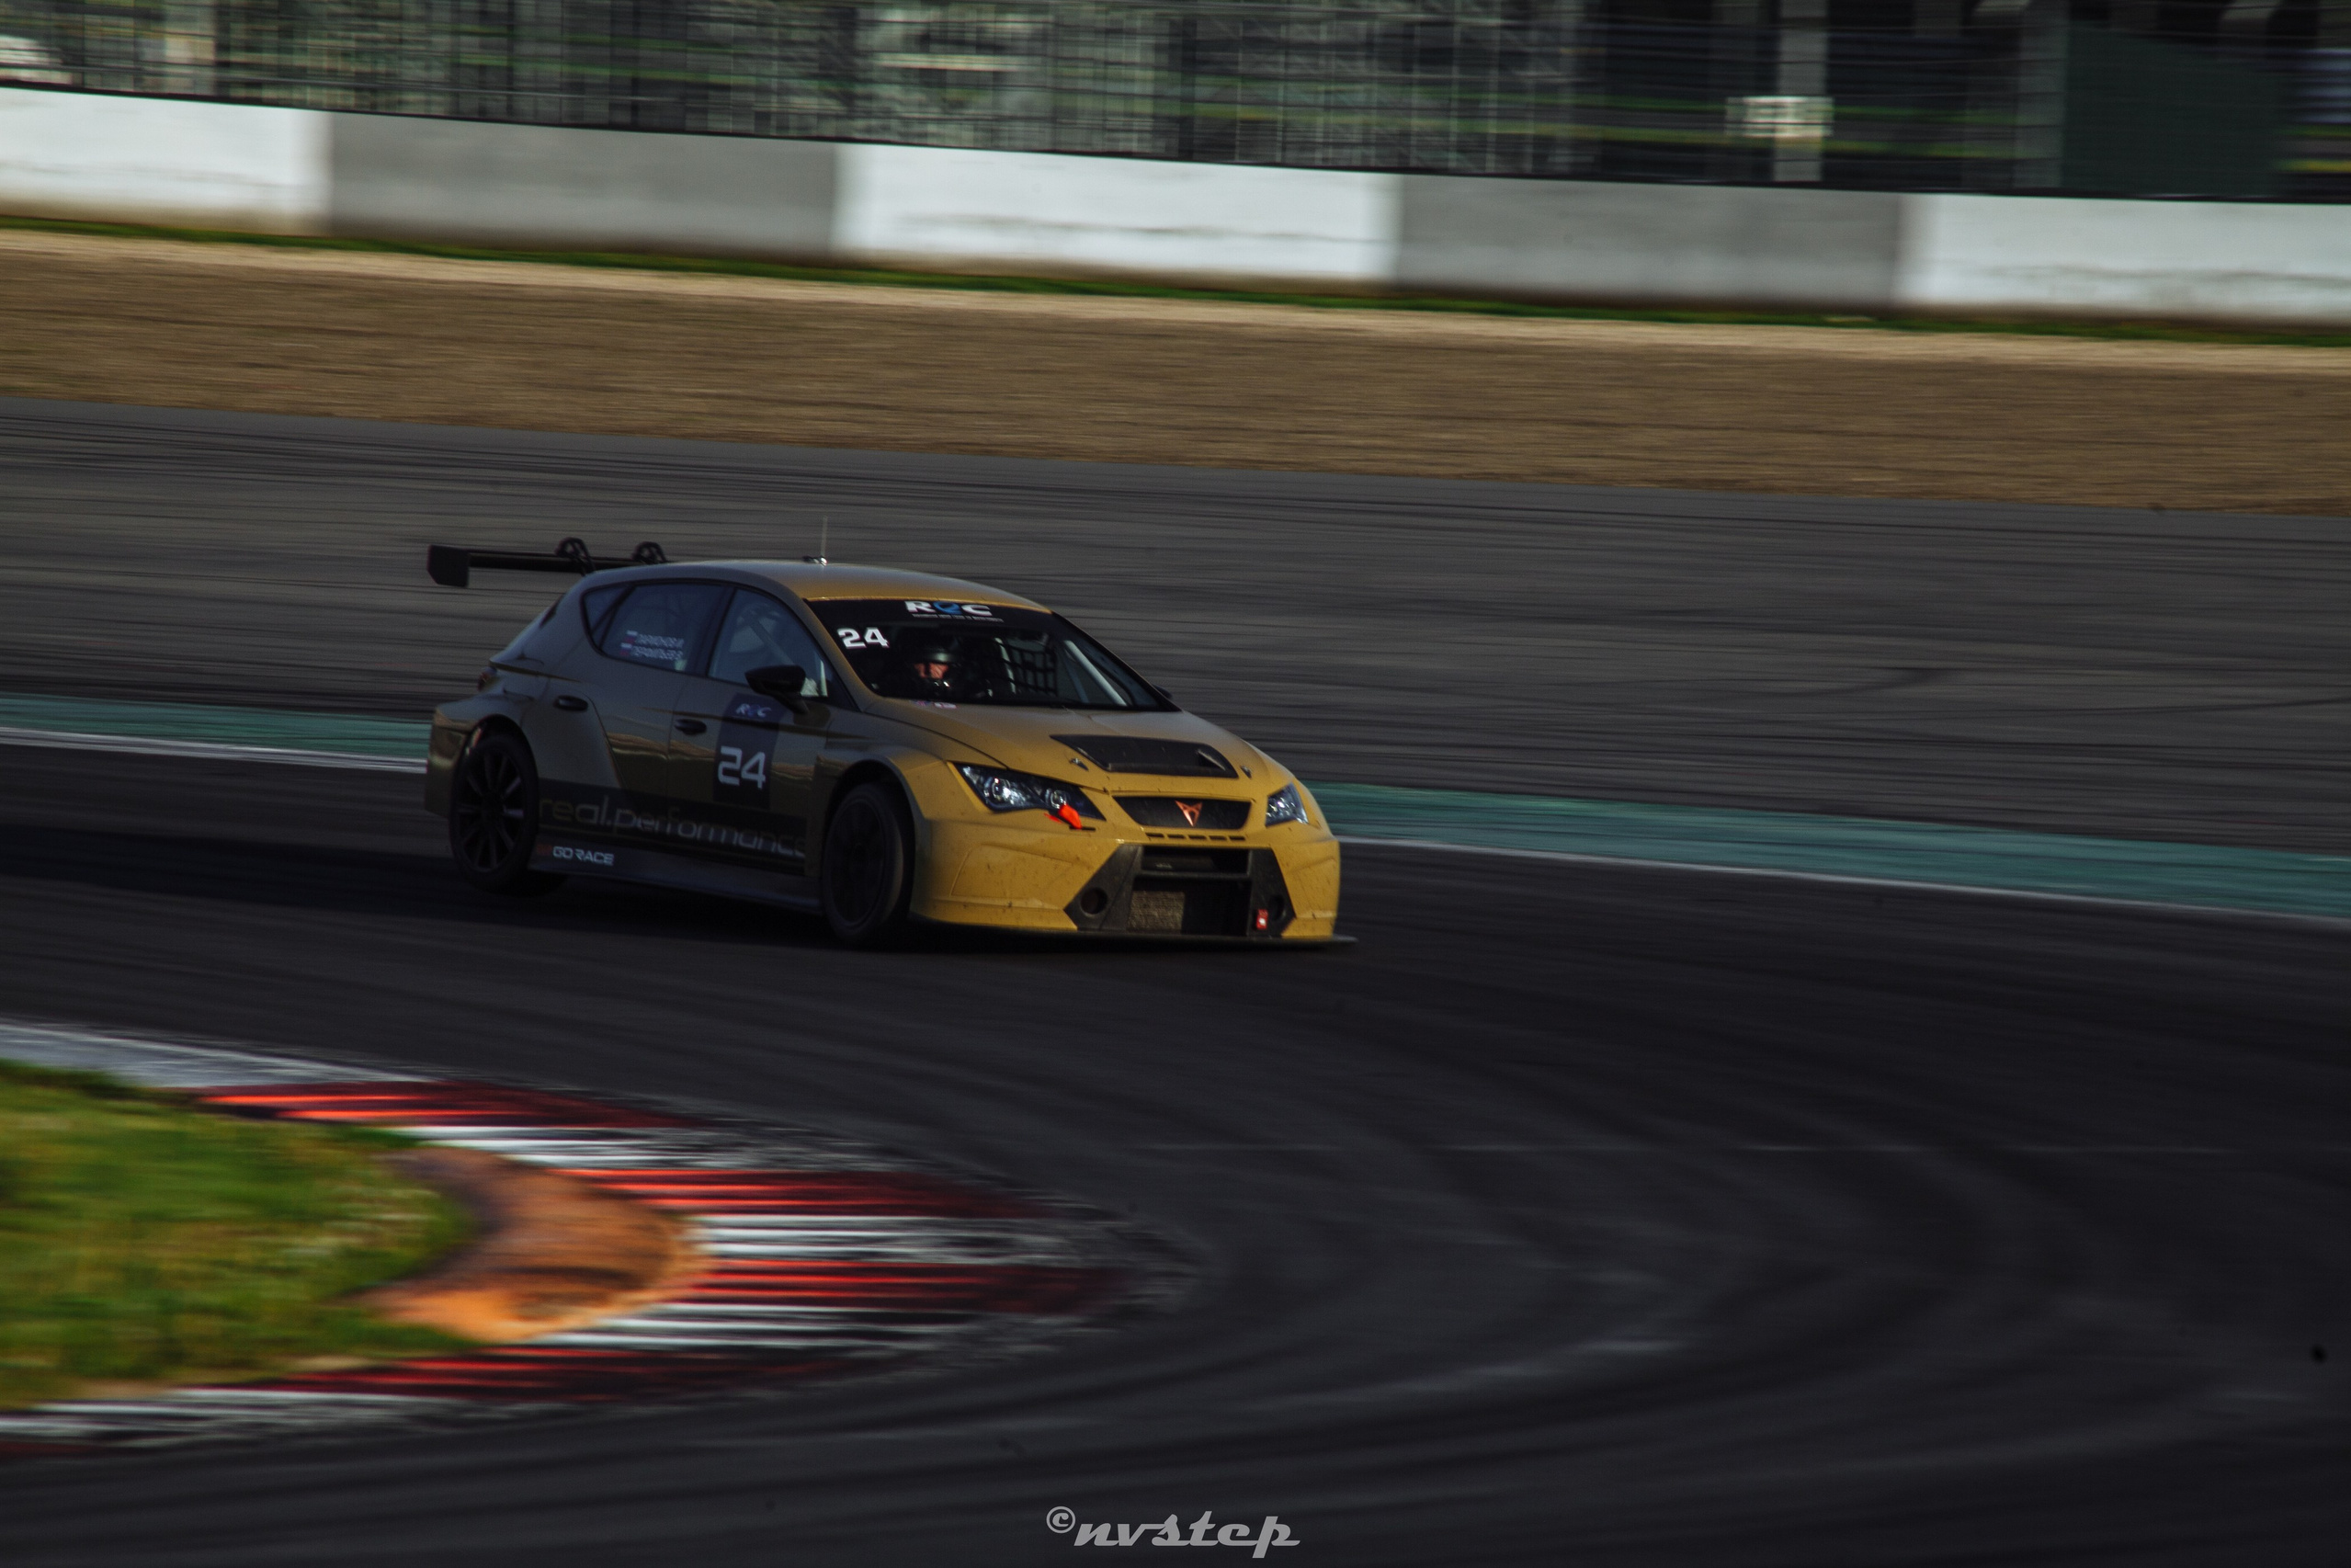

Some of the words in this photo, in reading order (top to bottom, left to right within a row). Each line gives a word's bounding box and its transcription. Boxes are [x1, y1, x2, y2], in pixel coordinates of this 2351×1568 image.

[836, 627, 890, 649] 24
[718, 745, 767, 790] 24
[552, 846, 574, 860] GO
[574, 848, 615, 866] RACE
